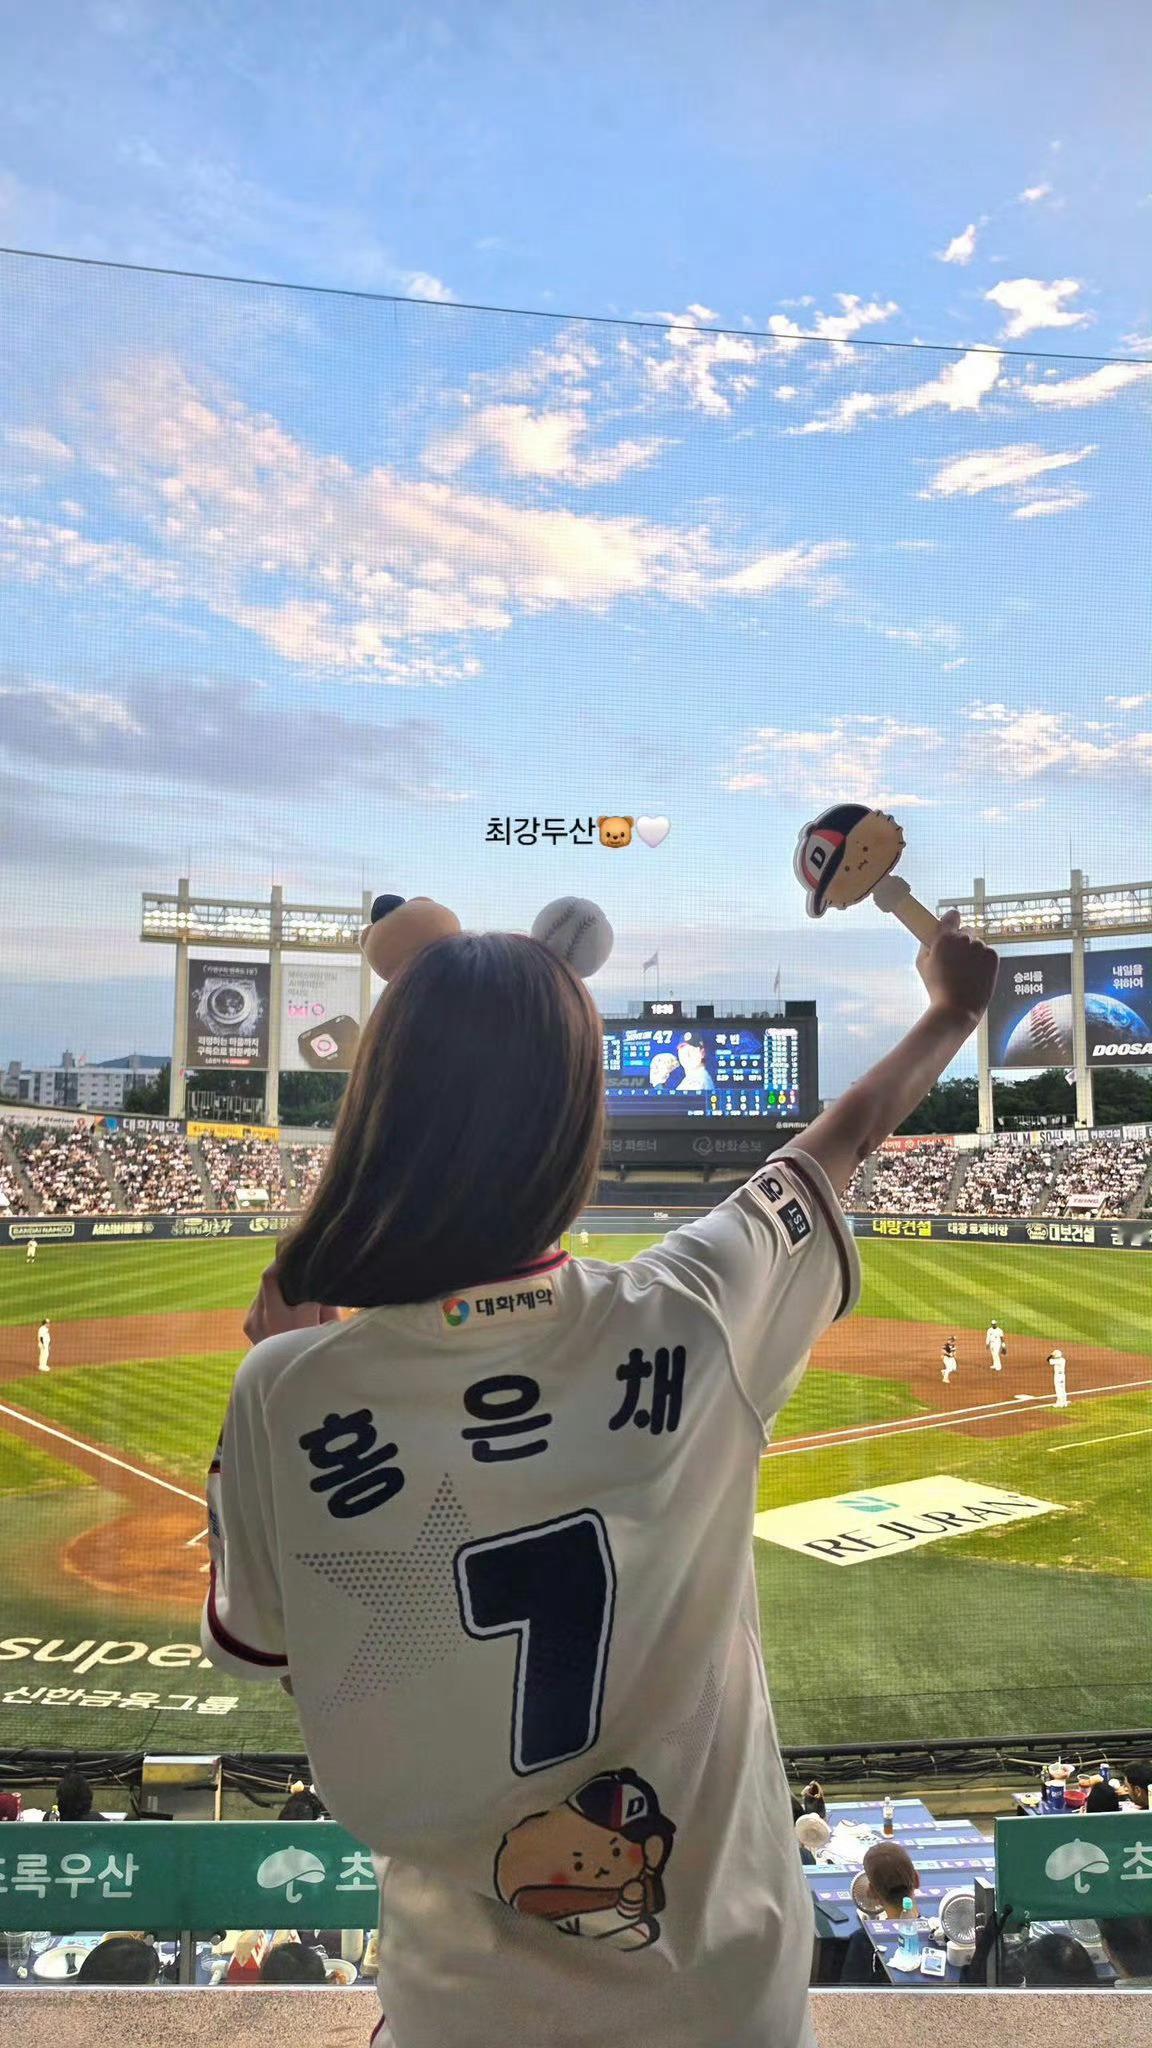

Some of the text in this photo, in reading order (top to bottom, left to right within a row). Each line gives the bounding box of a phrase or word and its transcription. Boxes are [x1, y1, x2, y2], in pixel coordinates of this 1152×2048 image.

[810, 846, 826, 869] D
[1014, 971, 1043, 983] 승리를
[1113, 964, 1143, 976] 내일을
[1014, 983, 1043, 995] 위하여
[1113, 977, 1143, 989] 위하여
[653, 1030, 673, 1044] 47
[122, 1118, 180, 1133] 대화제약
[787, 1207, 806, 1233] EST
[475, 1289, 553, 1316] 대화제약
[803, 1498, 1039, 1558] REJURAN
[454, 1508, 617, 1777] 7
[4, 1687, 239, 1714] 신한금융그룹
[625, 1796, 645, 1819] D
